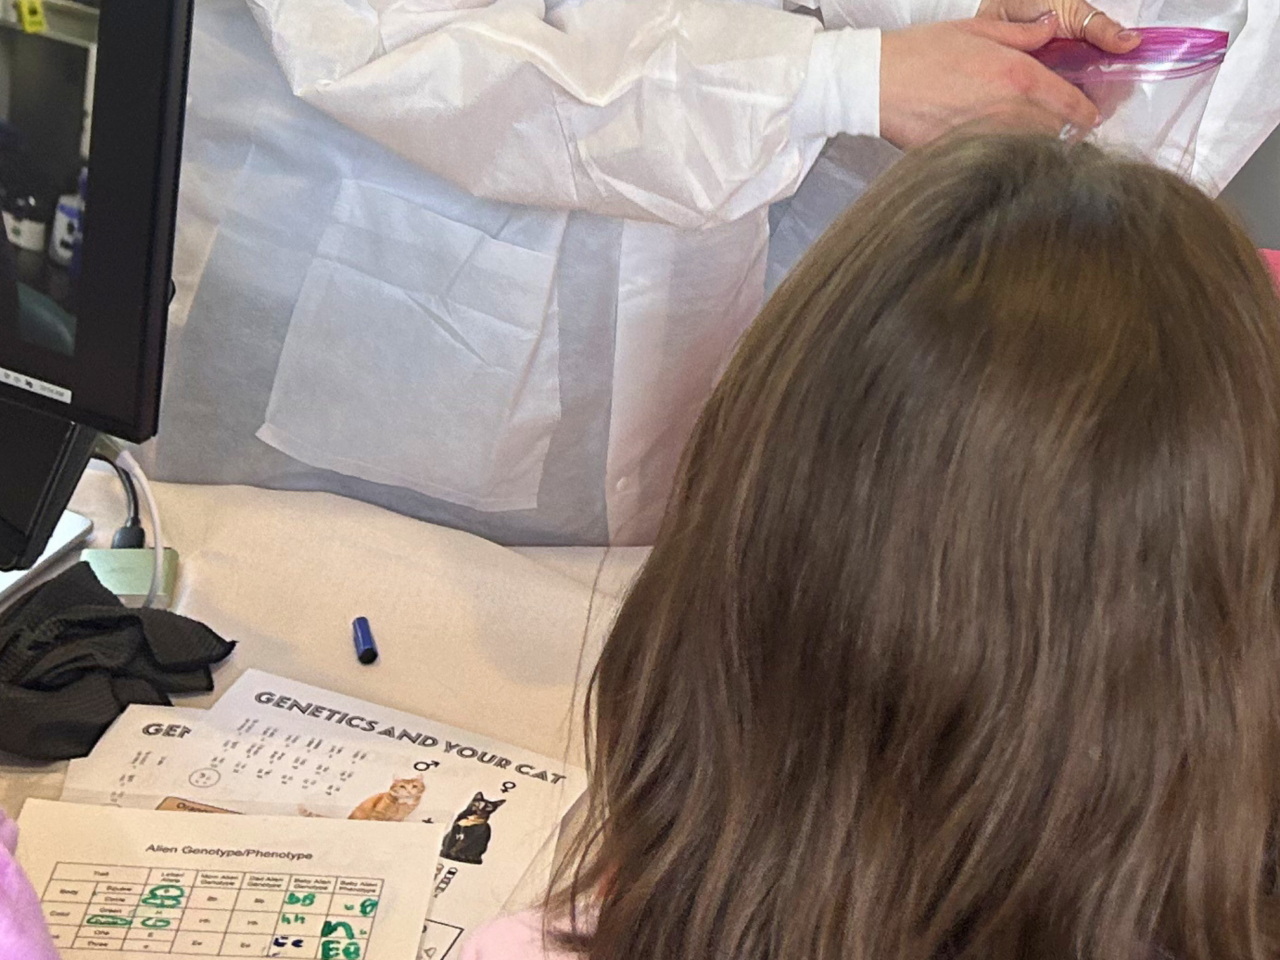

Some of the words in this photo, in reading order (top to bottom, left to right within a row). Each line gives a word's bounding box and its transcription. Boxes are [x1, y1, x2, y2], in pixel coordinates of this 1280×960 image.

[254, 691, 379, 733] GENETICS
[377, 726, 439, 748] AND
[444, 740, 512, 770] YOUR
[515, 763, 566, 785] CAT
[146, 844, 177, 853] Alien
[182, 845, 313, 860] Genotype/Phenotype
